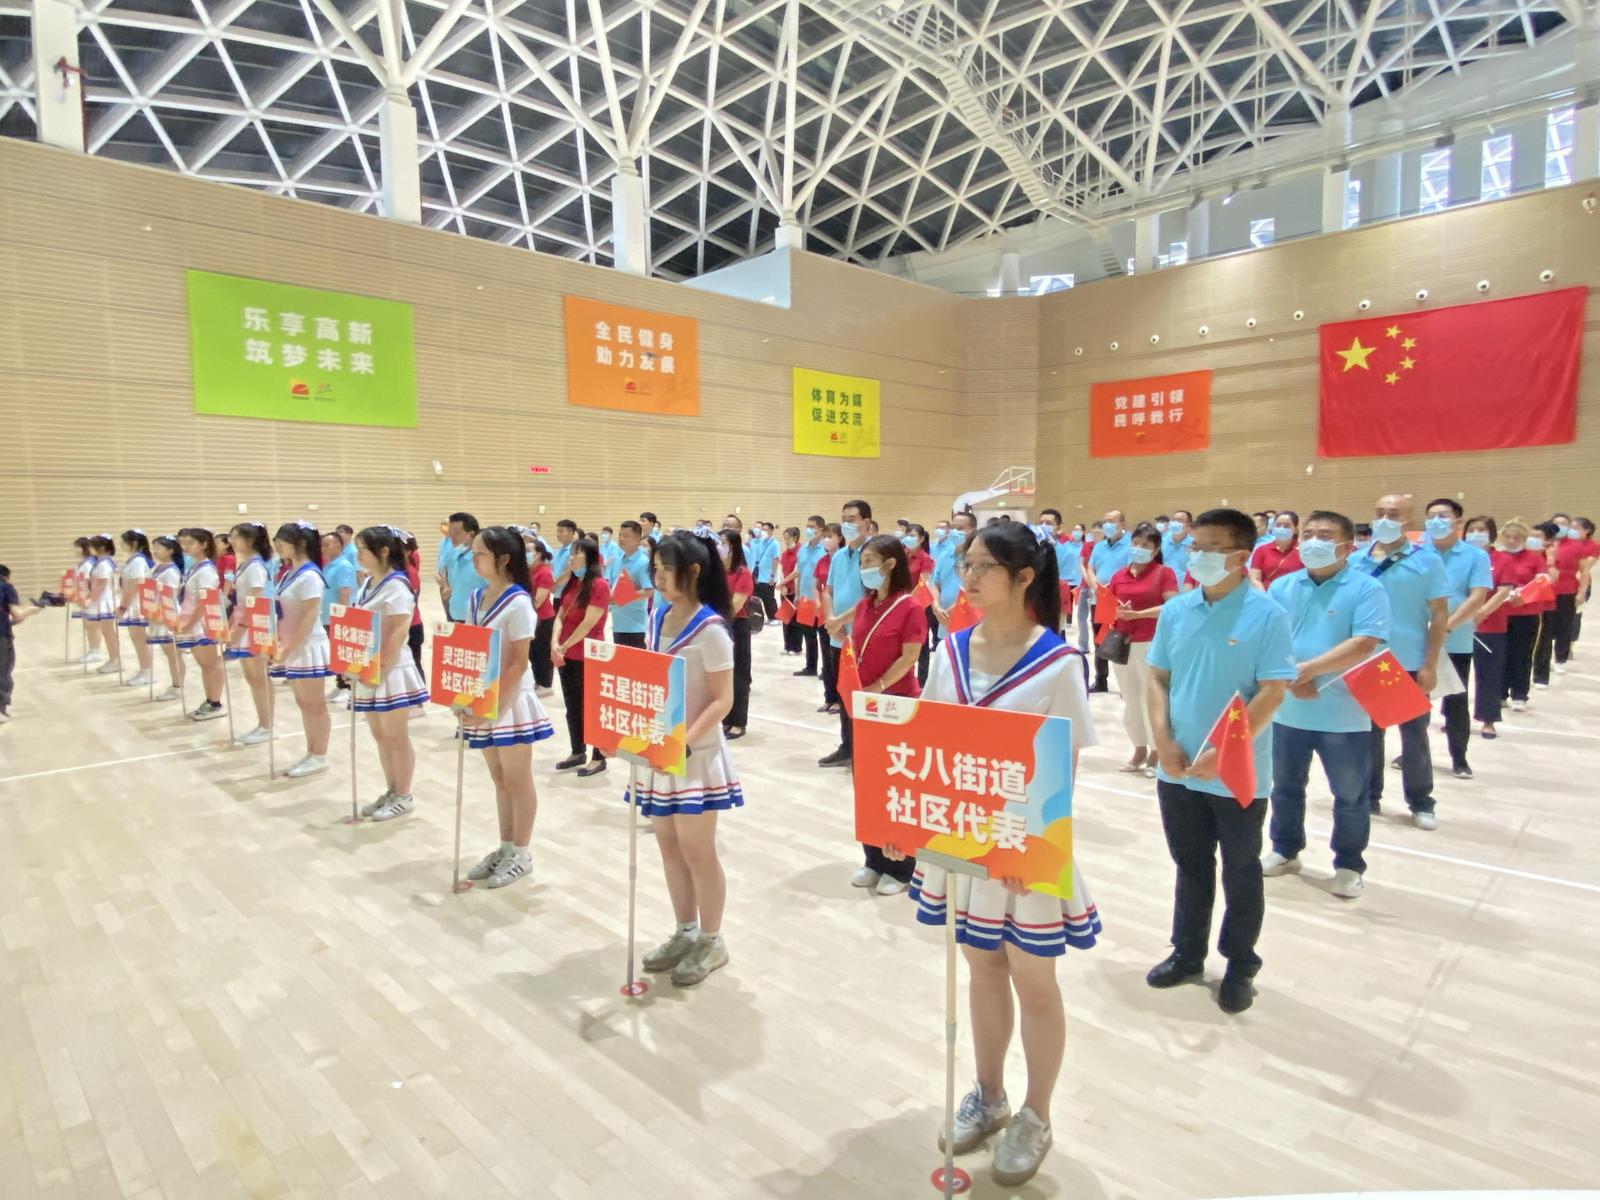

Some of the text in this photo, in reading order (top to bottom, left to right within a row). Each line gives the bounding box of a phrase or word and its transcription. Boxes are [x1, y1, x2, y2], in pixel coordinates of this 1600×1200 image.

[243, 307, 373, 345] 乐享高新
[594, 320, 673, 351] 全民健身
[244, 338, 375, 375] 筑梦未来
[596, 345, 675, 374] 助力发展
[811, 388, 863, 407] 体育为媒
[1114, 388, 1184, 410] 党建引领
[811, 408, 863, 426] 促进交流
[442, 645, 488, 673] 灵沼街道
[441, 670, 486, 699] 社区代表
[599, 672, 666, 713] 五星街道
[599, 703, 666, 747] 社区代表
[886, 742, 1029, 804] 丈八街道
[886, 786, 1029, 855] 社区代表
